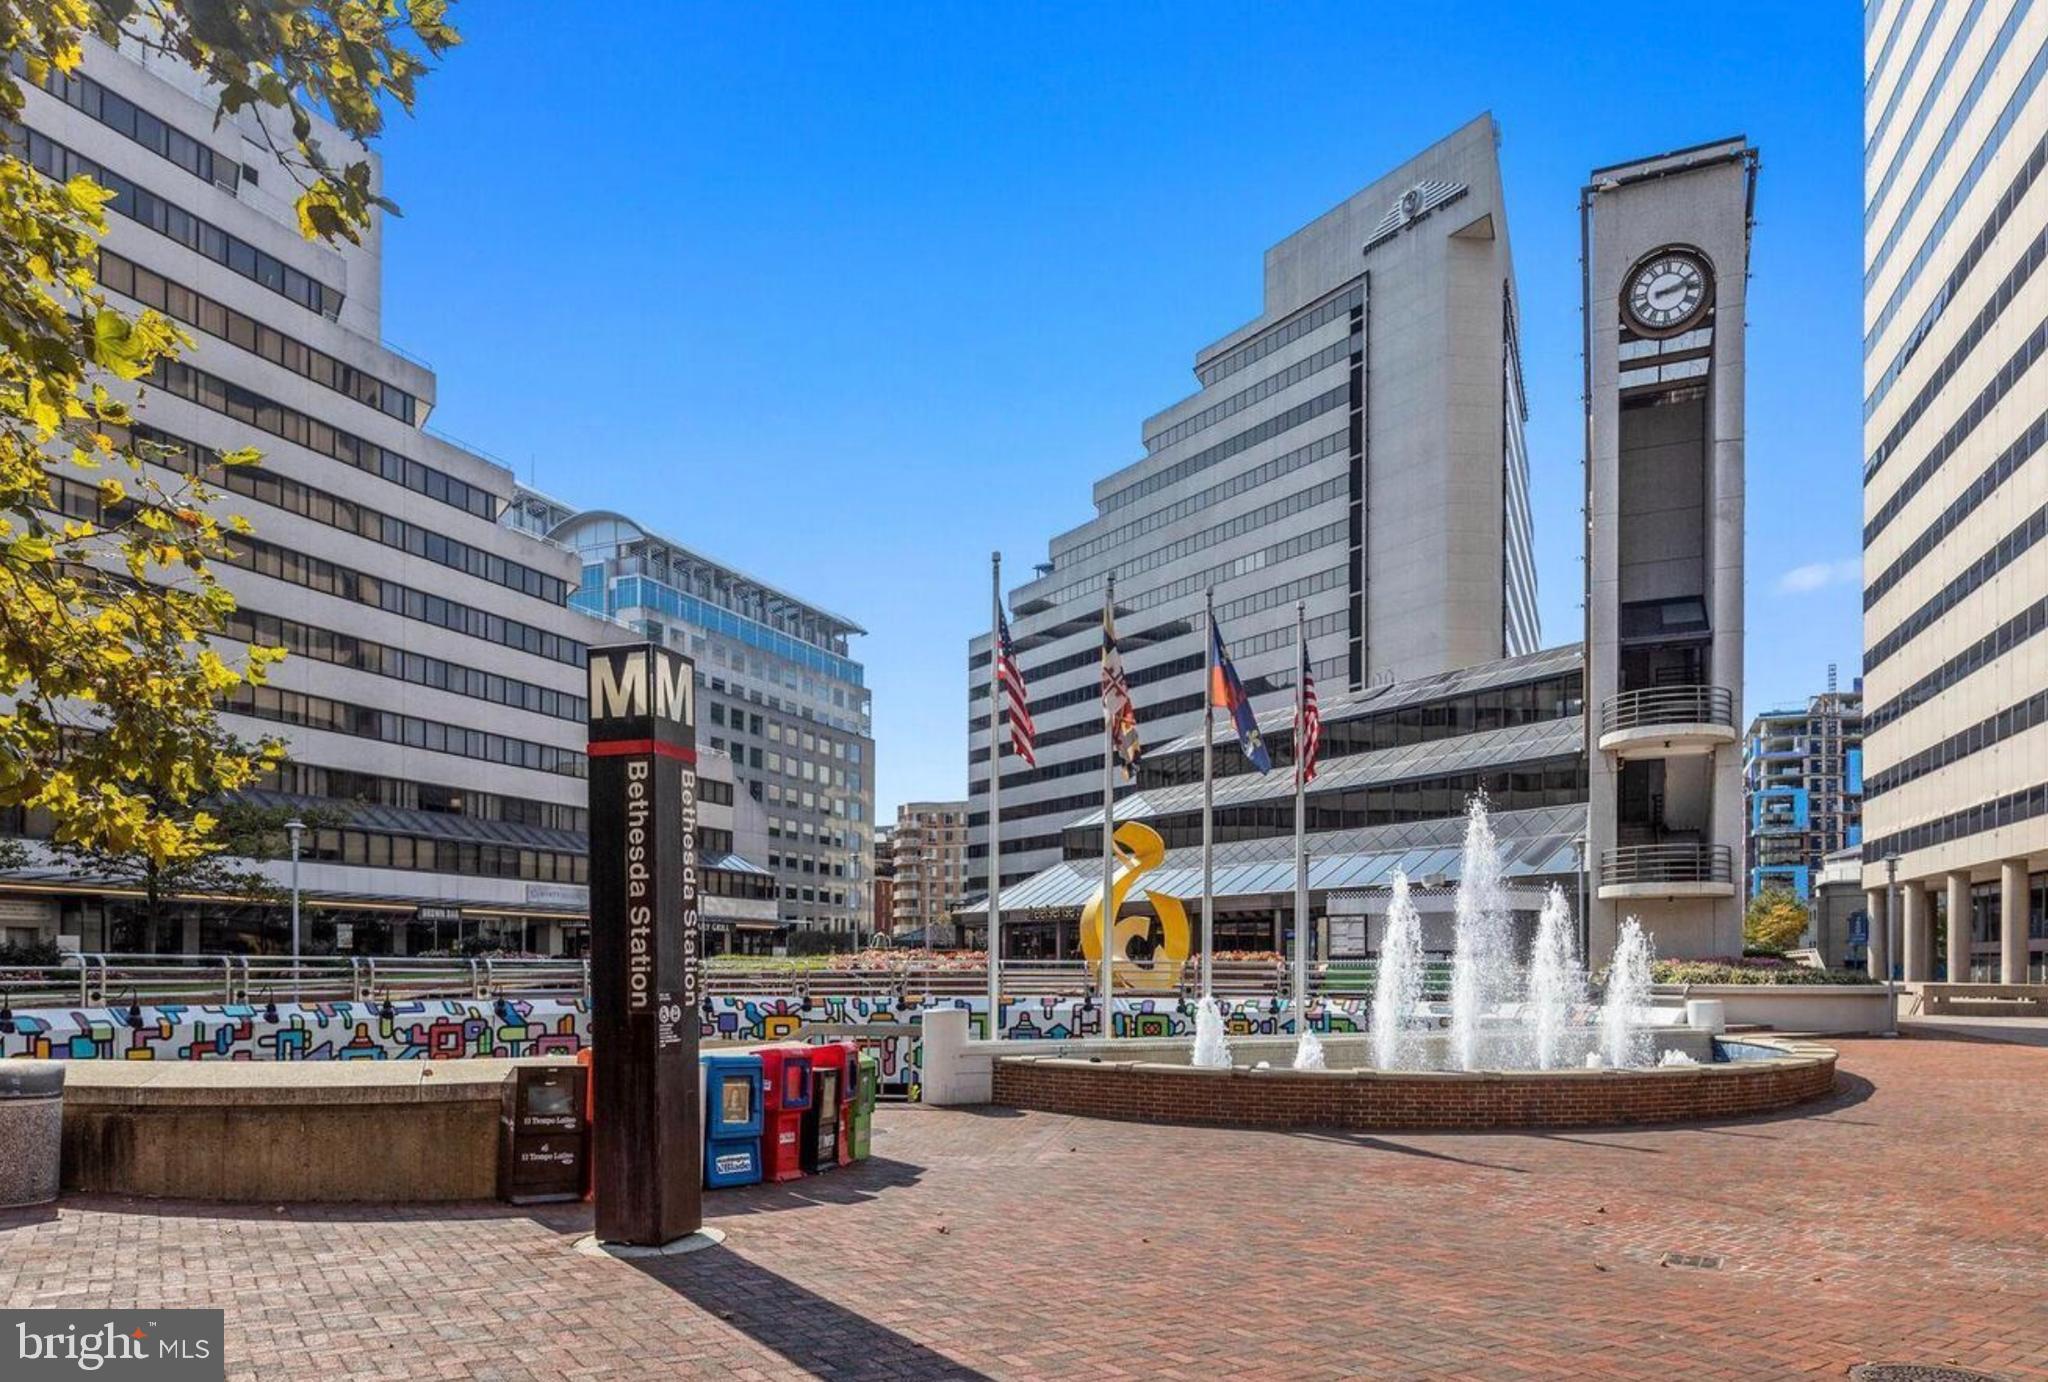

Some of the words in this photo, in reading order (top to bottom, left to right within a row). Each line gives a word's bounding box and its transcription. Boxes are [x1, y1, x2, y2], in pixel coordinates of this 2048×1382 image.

[590, 651, 648, 719] M
[656, 651, 693, 727] M
[627, 761, 650, 897] Bethesda
[681, 768, 696, 900] Bethesda
[629, 905, 651, 1008] Station
[683, 908, 698, 1007] Station
